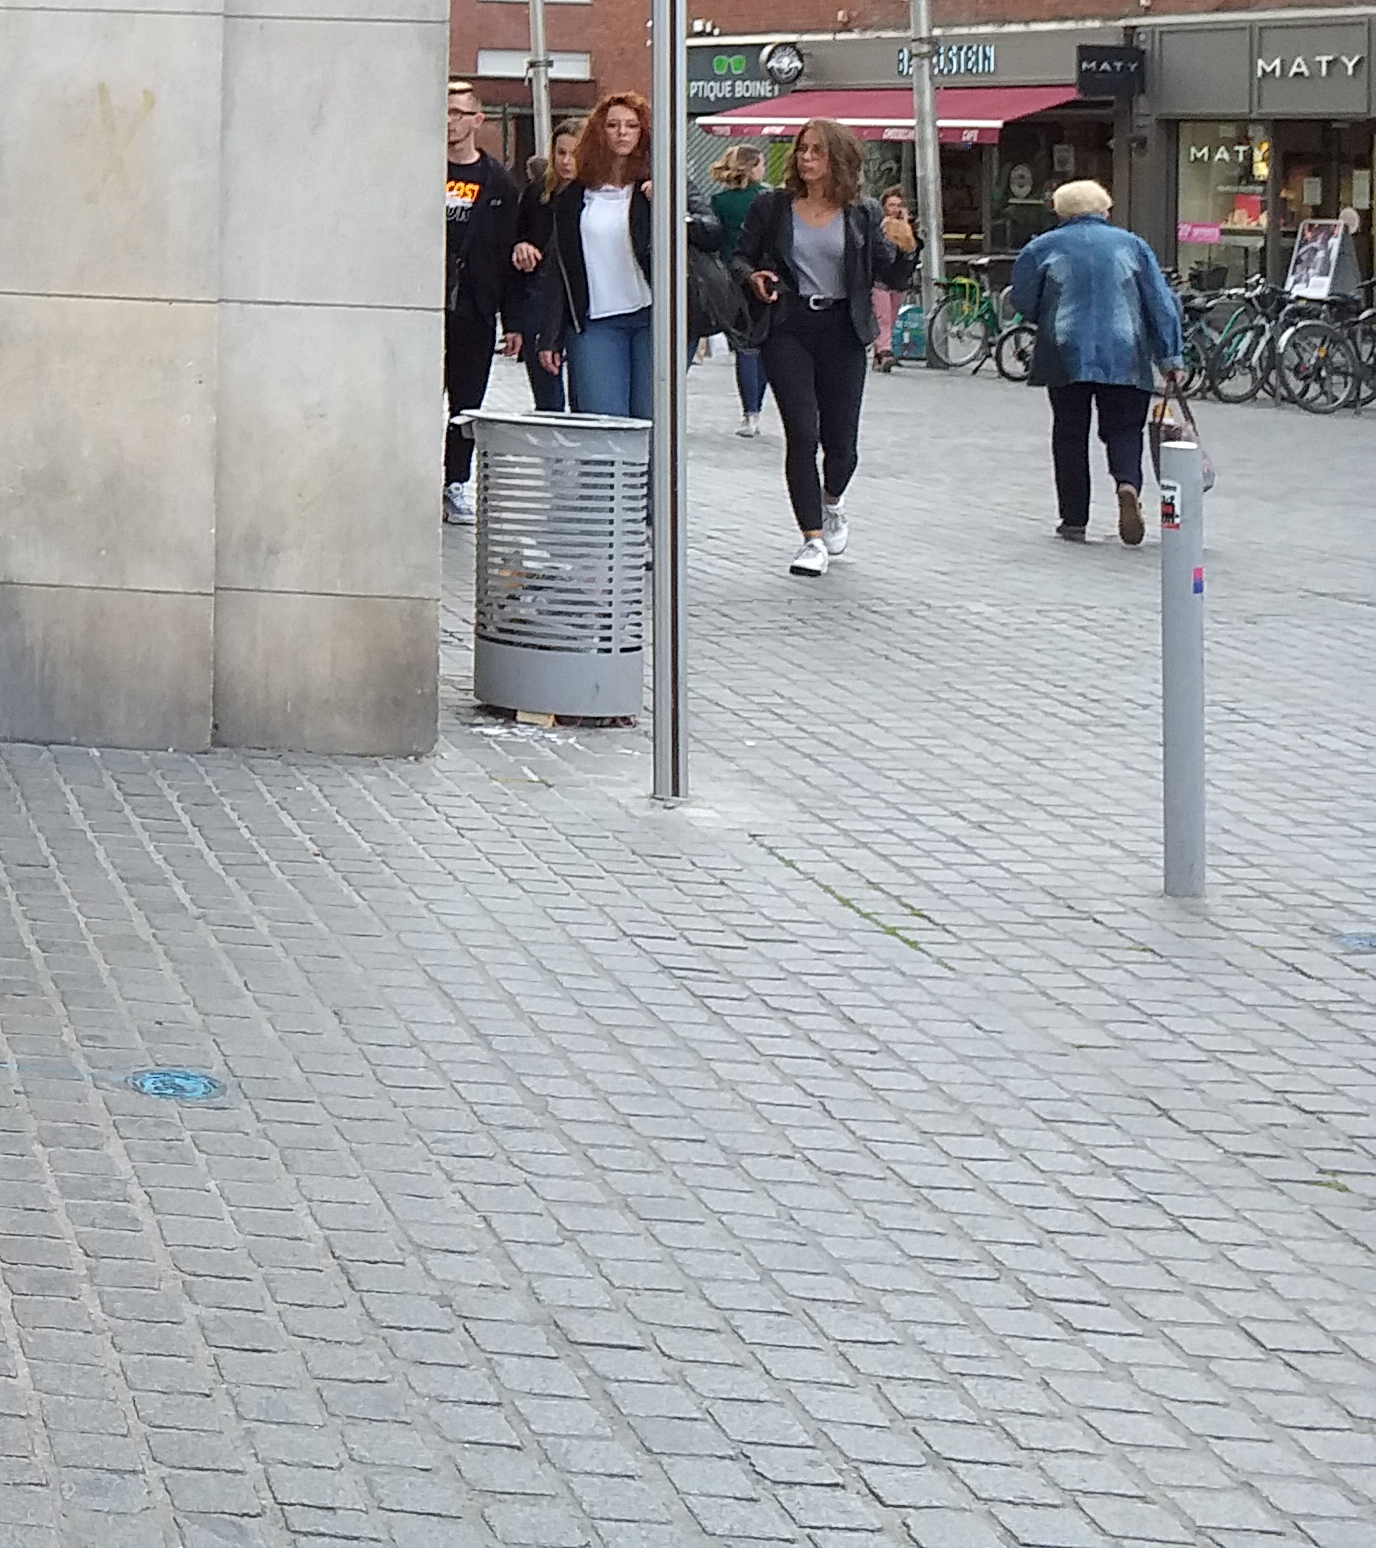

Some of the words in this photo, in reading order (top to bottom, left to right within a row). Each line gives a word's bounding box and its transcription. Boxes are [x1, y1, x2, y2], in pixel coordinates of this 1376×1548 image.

[1081, 61, 1139, 73] MATY
[1256, 54, 1363, 79] MATY
[1189, 145, 1268, 163] MATY
